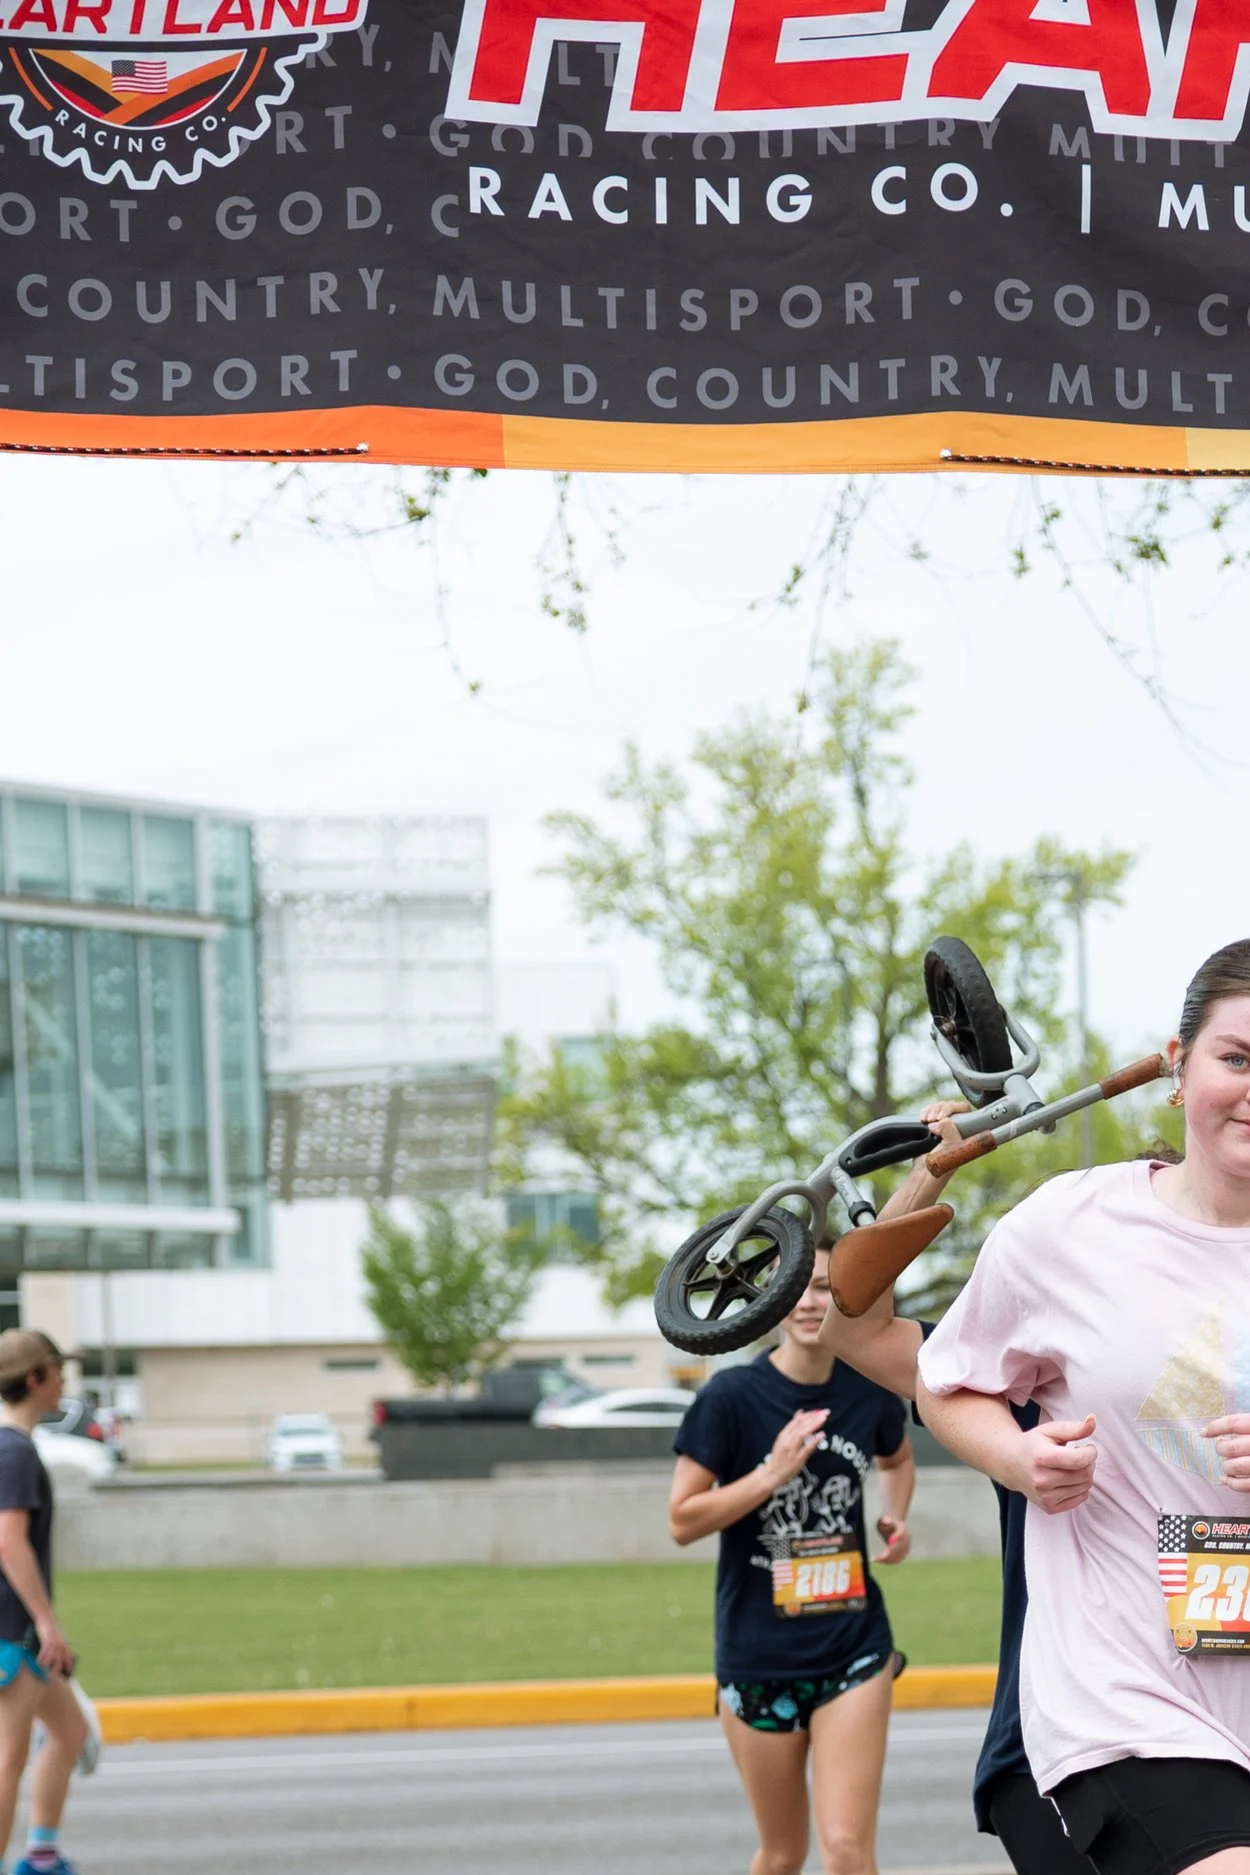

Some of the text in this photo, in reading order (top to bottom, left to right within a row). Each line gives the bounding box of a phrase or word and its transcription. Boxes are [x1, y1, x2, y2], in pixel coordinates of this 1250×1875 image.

[56, 110, 166, 152] RACING
[186, 115, 226, 141] CO.
[216, 187, 393, 240] GOD,
[469, 165, 812, 224] RACING
[871, 163, 1013, 216] CO.
[17, 268, 396, 323] COUNTRY,
[433, 275, 919, 331] MULTISPORT
[994, 279, 1162, 336] GOD,
[434, 354, 609, 409] GOD,
[647, 355, 1013, 409] COUNTRY,
